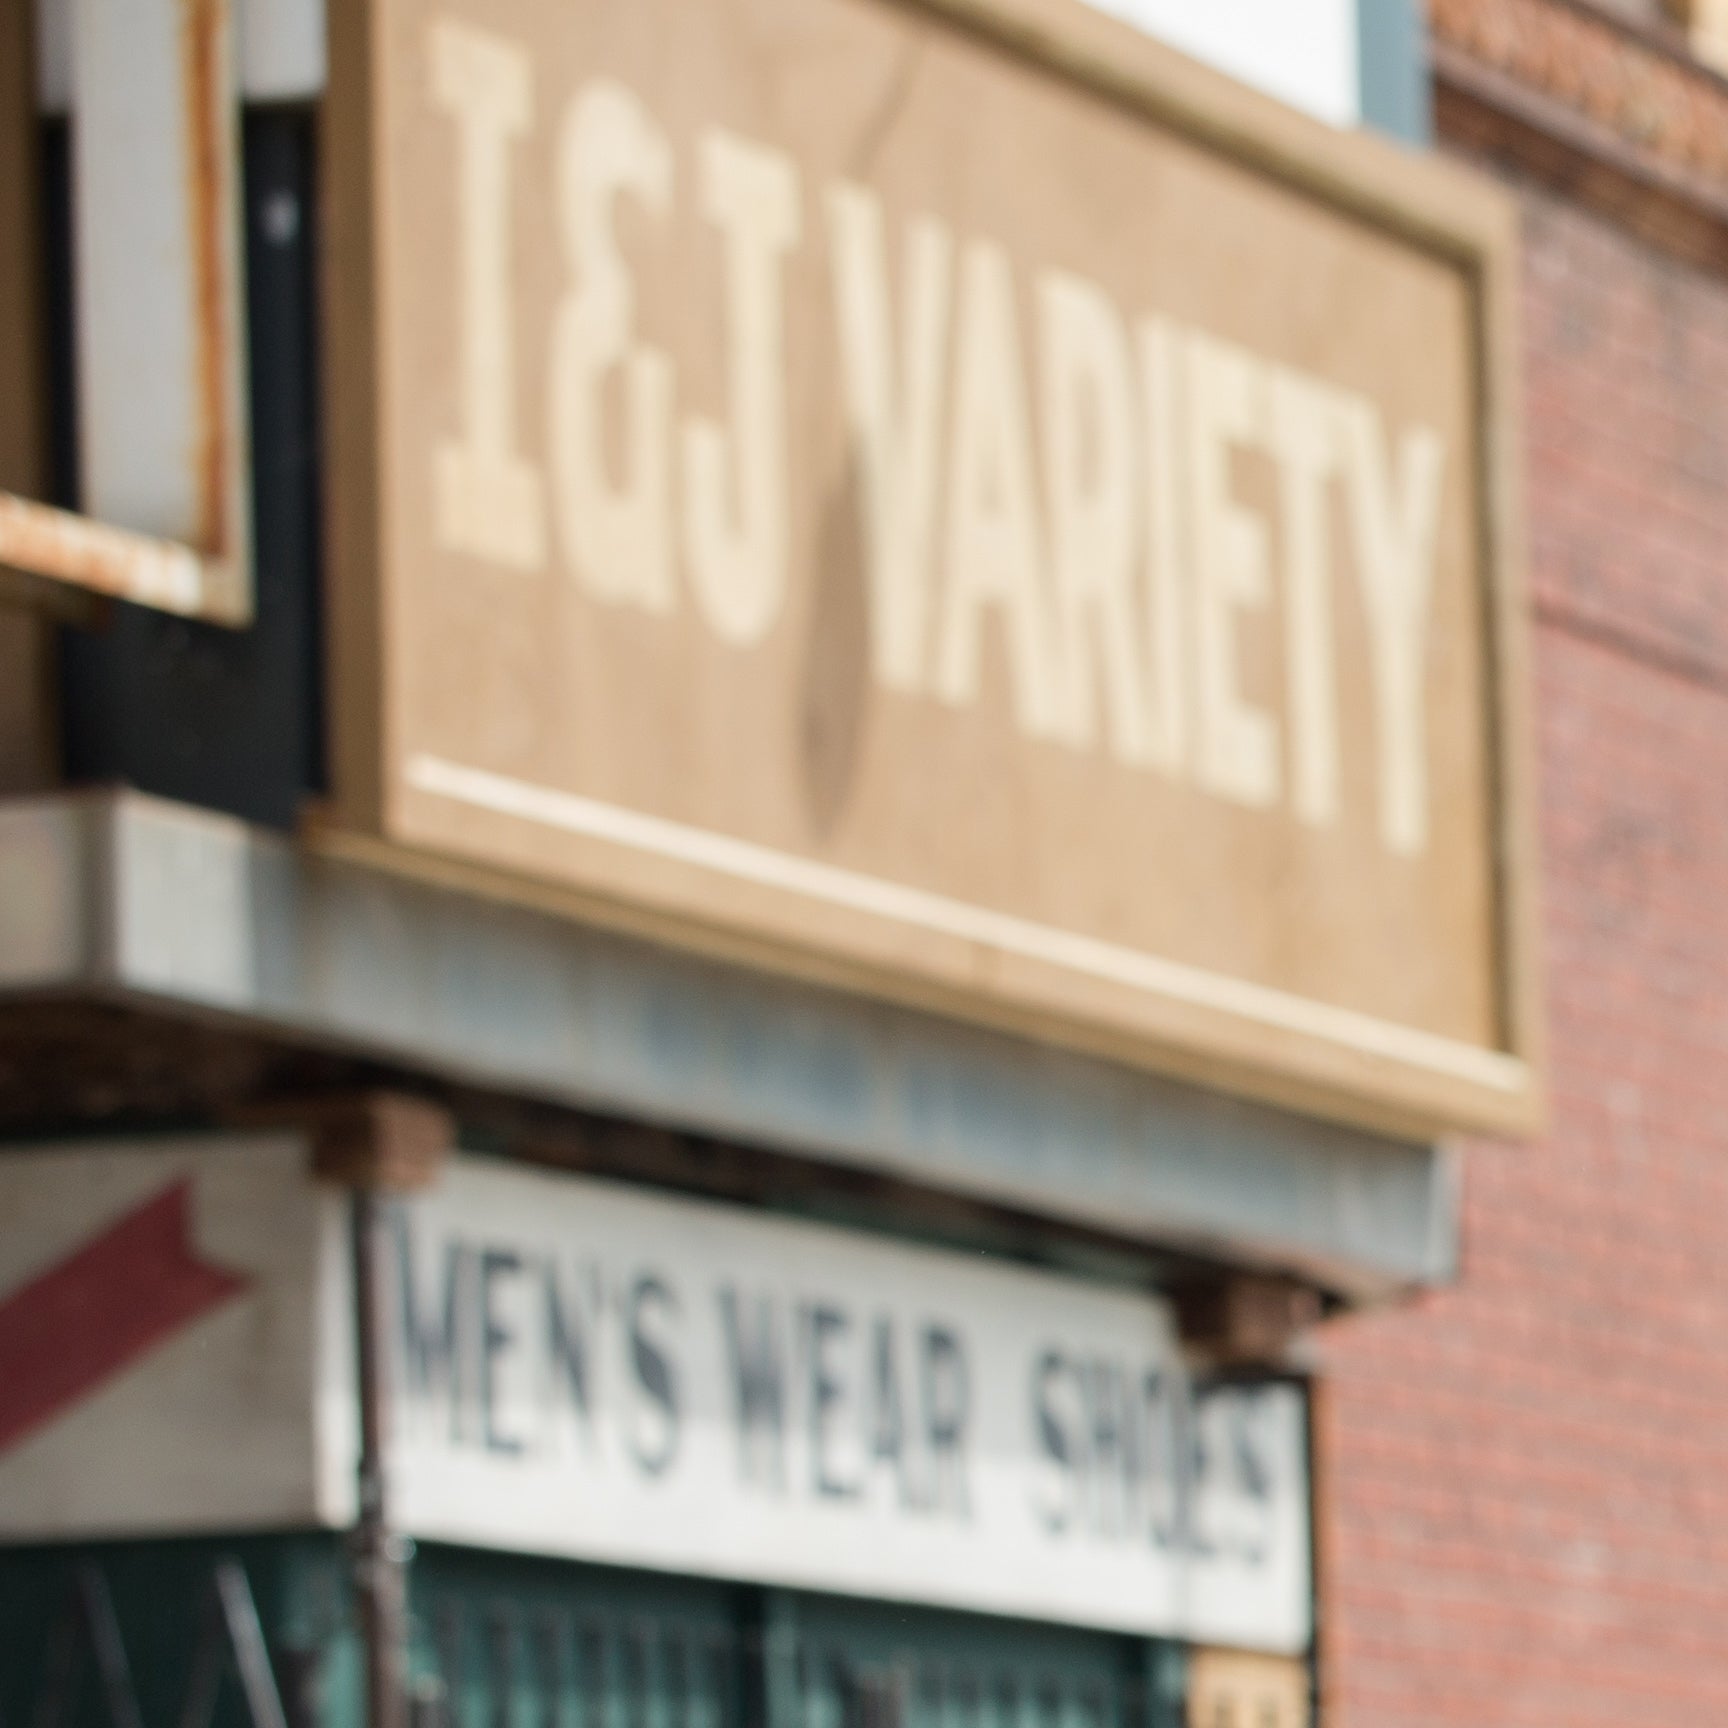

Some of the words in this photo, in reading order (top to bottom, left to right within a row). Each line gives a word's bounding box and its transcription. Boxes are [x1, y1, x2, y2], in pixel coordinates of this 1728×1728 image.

[822, 180, 1446, 860] VARIETY
[714, 1280, 976, 1528] WEAR
[1030, 1348, 1278, 1565] SHOES
